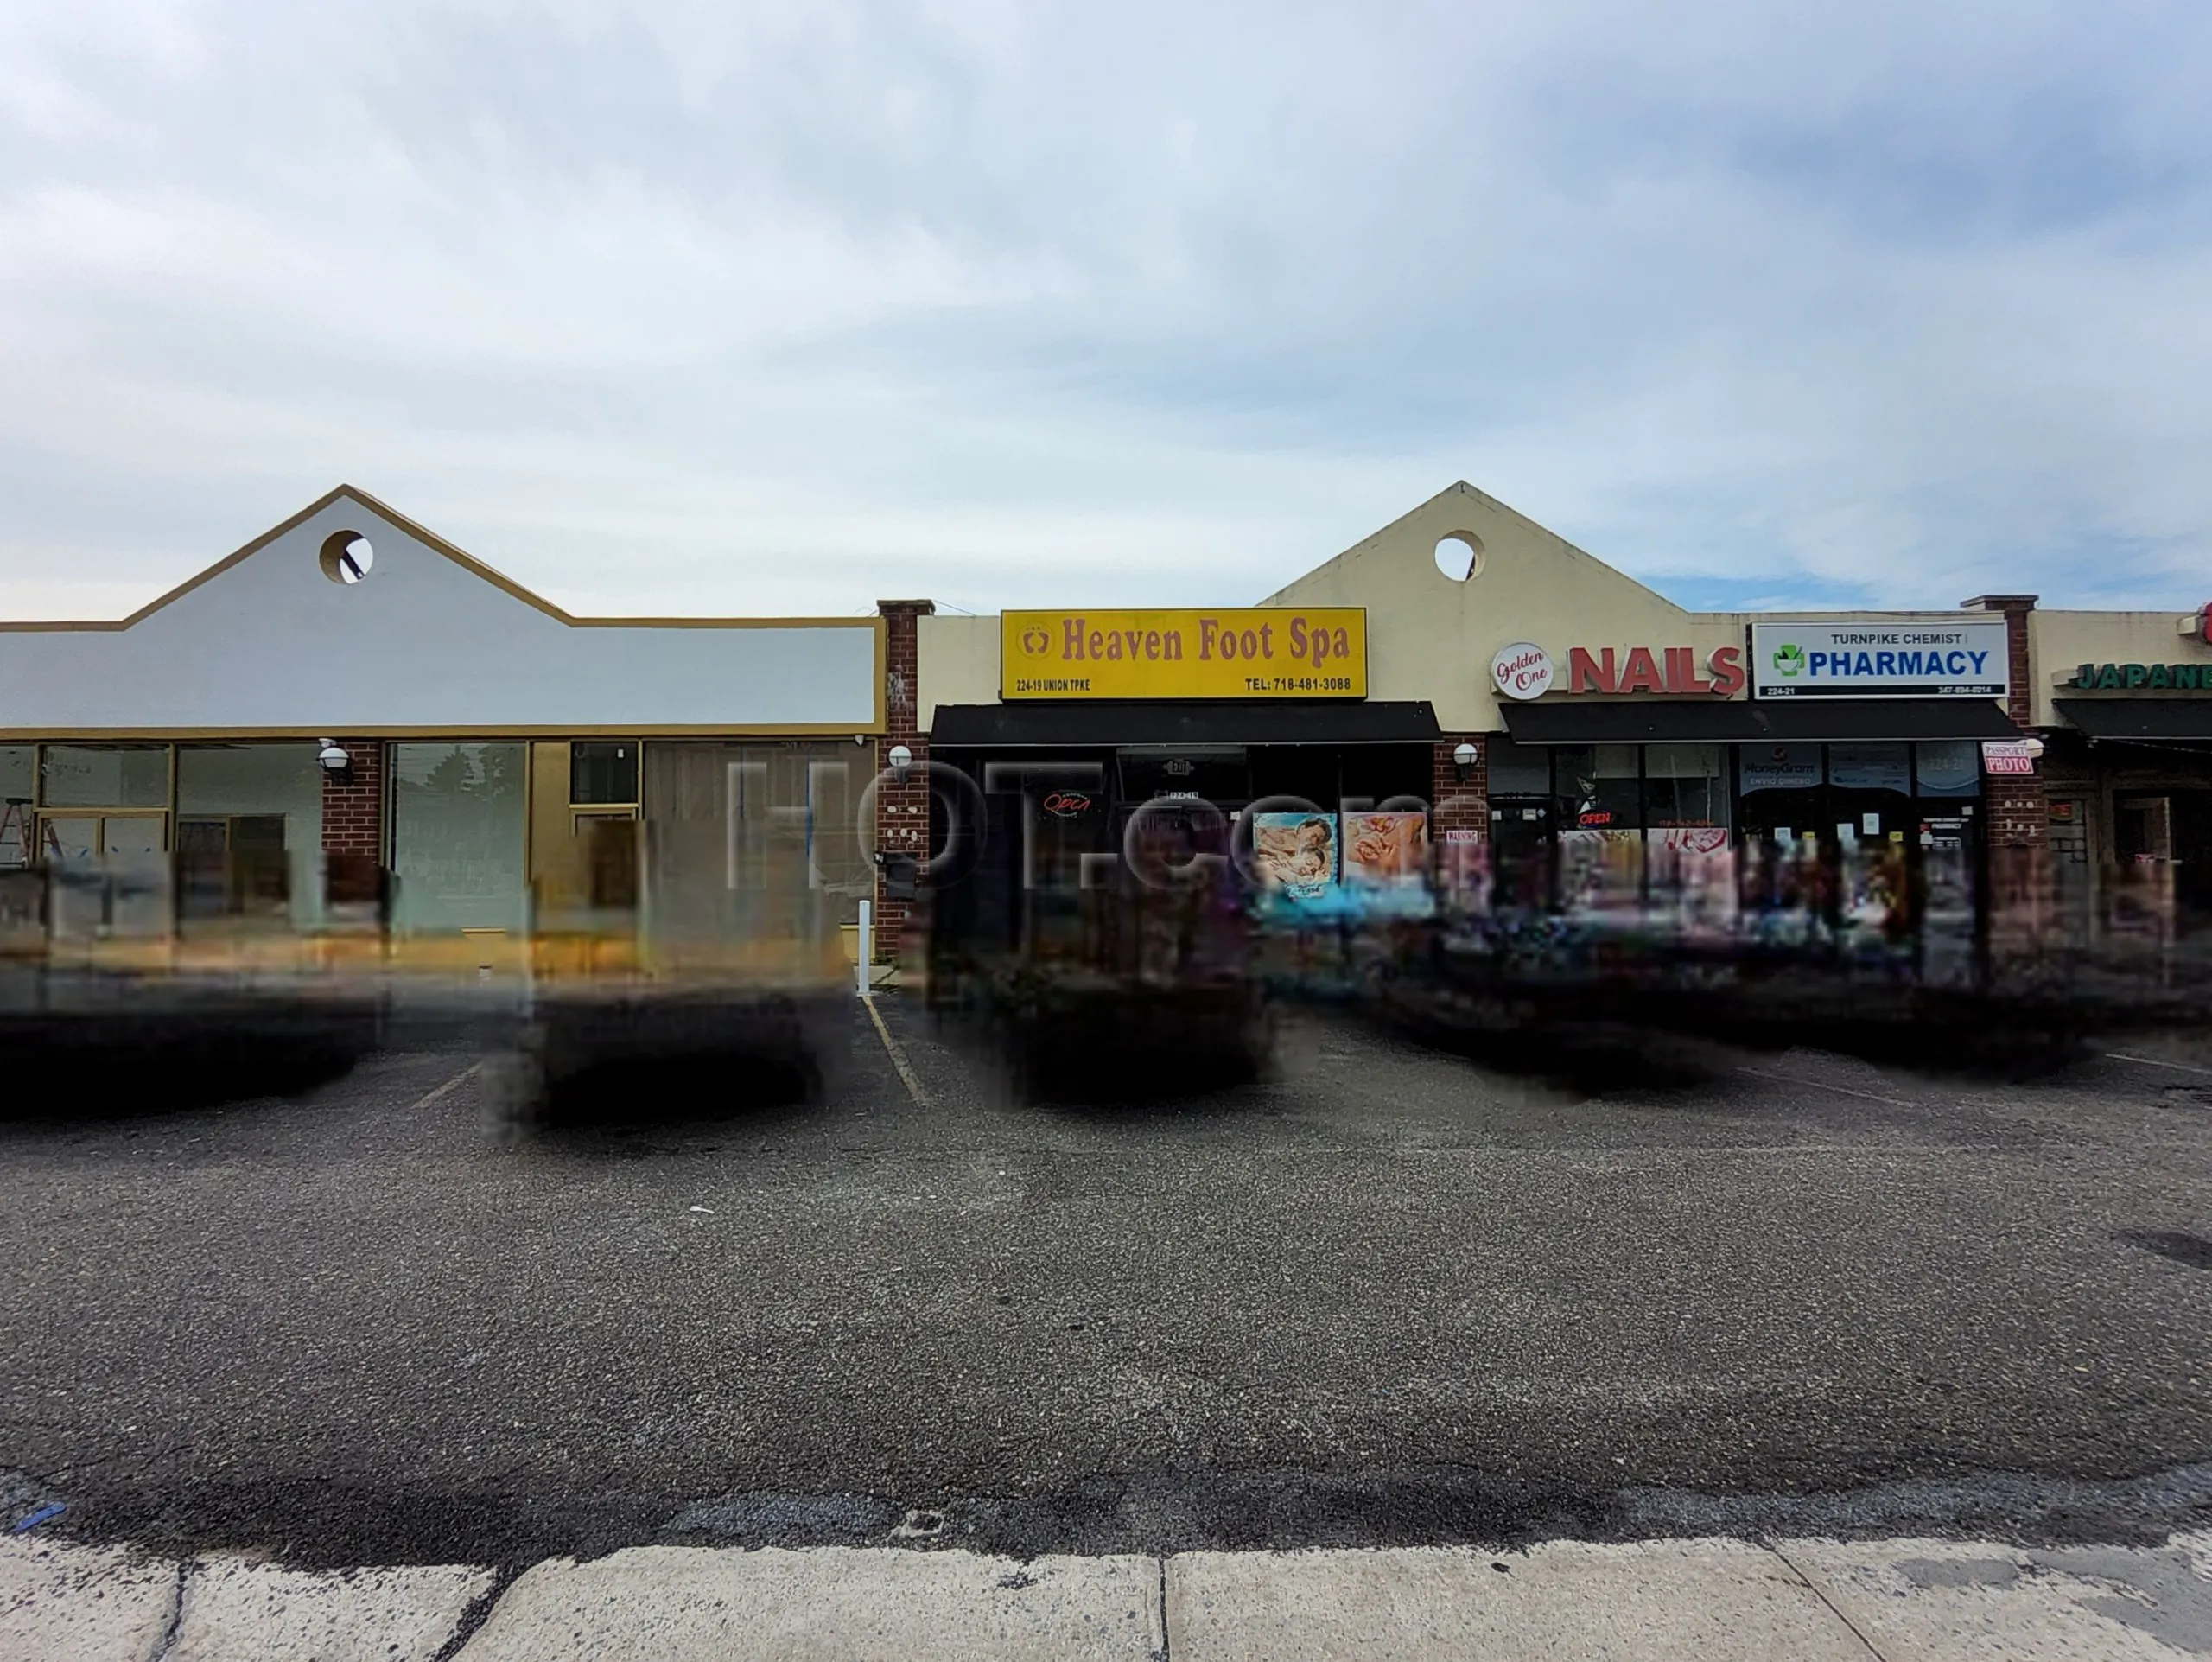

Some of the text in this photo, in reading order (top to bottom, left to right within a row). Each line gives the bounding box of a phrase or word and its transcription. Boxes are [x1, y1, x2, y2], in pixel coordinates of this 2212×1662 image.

[1062, 616, 1350, 668] Heaven Foot Spa
[1830, 634, 1961, 645] TURNPIKE CHEMIST
[1497, 651, 1544, 684] Golden
[1810, 650, 1989, 677] PHARMACY
[1567, 646, 1745, 695] NAILS
[1017, 678, 1090, 692] 224-19 UNION TPKE
[1245, 678, 1351, 691] TEL: 718-481-3088
[1516, 666, 1548, 692] One
[1767, 687, 1795, 696] 224-21
[1986, 746, 2026, 755] PASSPORT
[1745, 763, 1814, 776] MoneyGram
[1987, 758, 2030, 771] PHOTO
[1580, 812, 1611, 825] OPEN
[1448, 831, 1477, 842] WARNING
